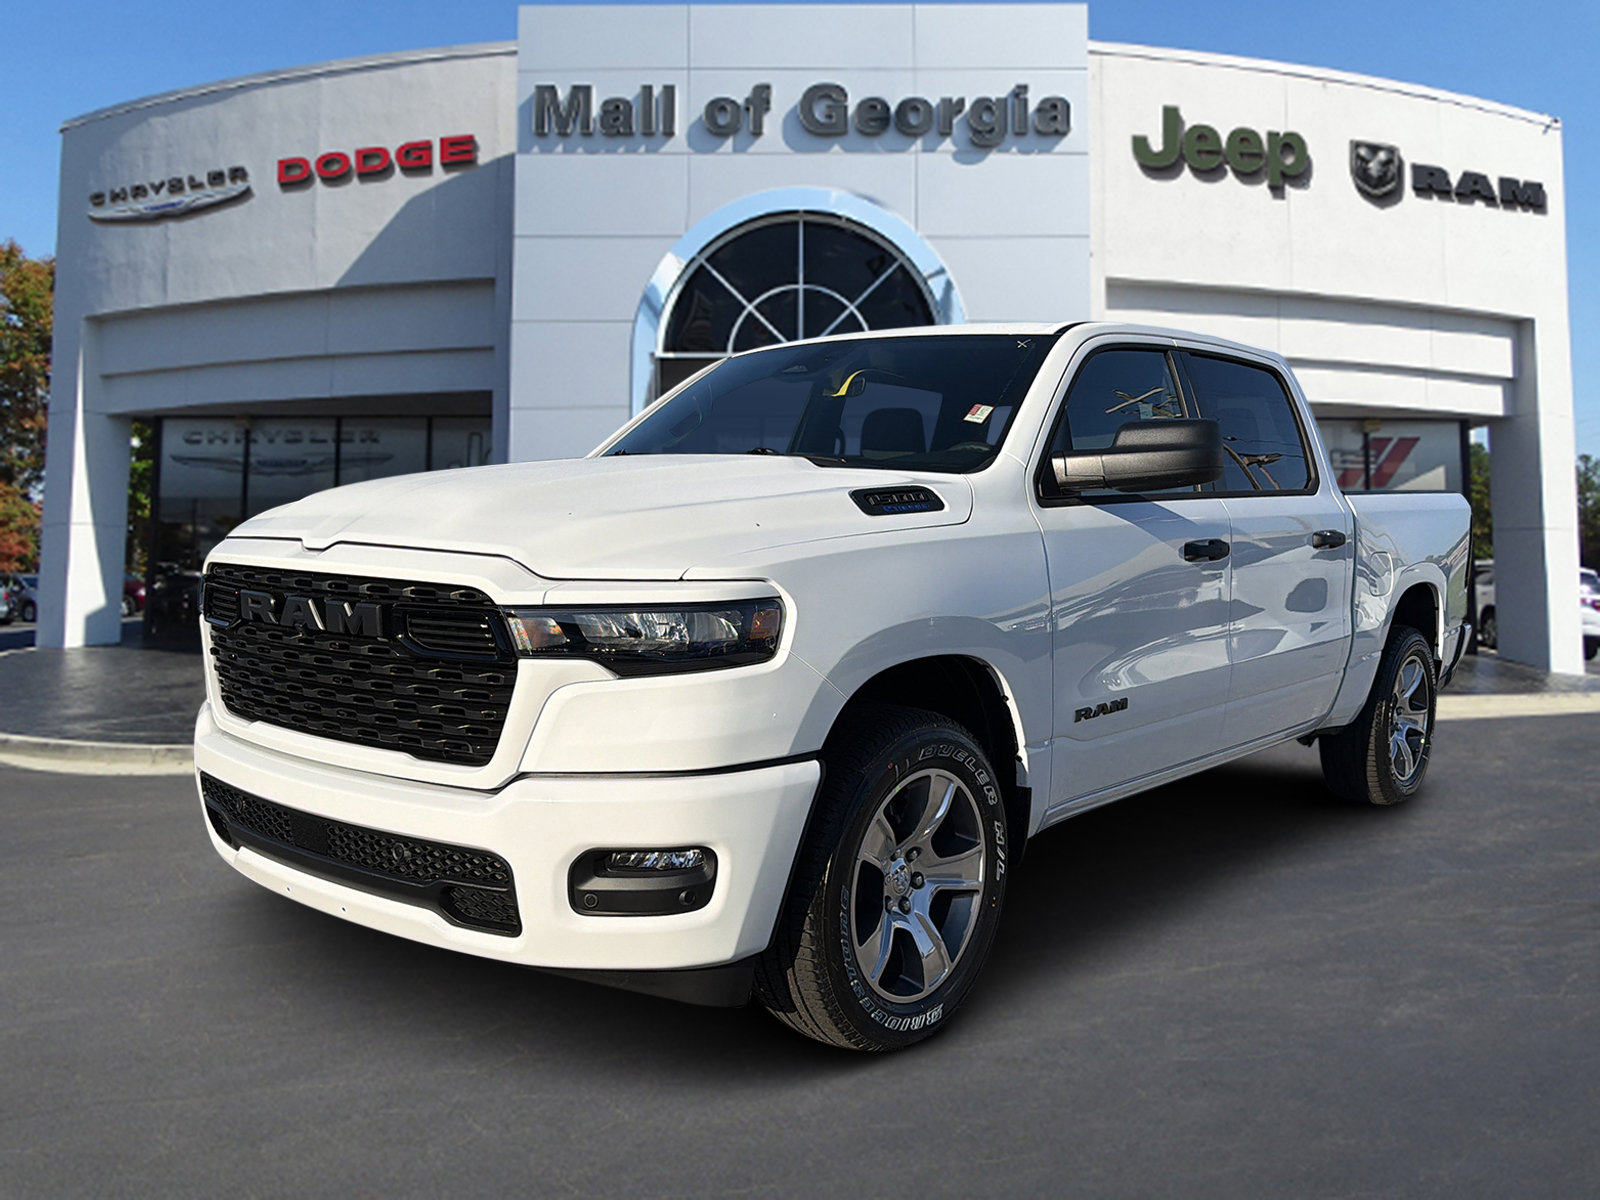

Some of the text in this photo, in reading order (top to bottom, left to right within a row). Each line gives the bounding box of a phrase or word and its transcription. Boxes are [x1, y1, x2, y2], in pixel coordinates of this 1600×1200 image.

[532, 83, 1072, 148] Mall of Georgia
[277, 134, 476, 187] DODGE
[1131, 105, 1310, 190] Jeep
[89, 166, 249, 208] CHRYSLER
[1411, 163, 1547, 212] RAM
[183, 429, 381, 445] CHRYSLER
[240, 589, 386, 639] RAM
[1074, 697, 1129, 723] RAM
[919, 744, 998, 806] DUELER
